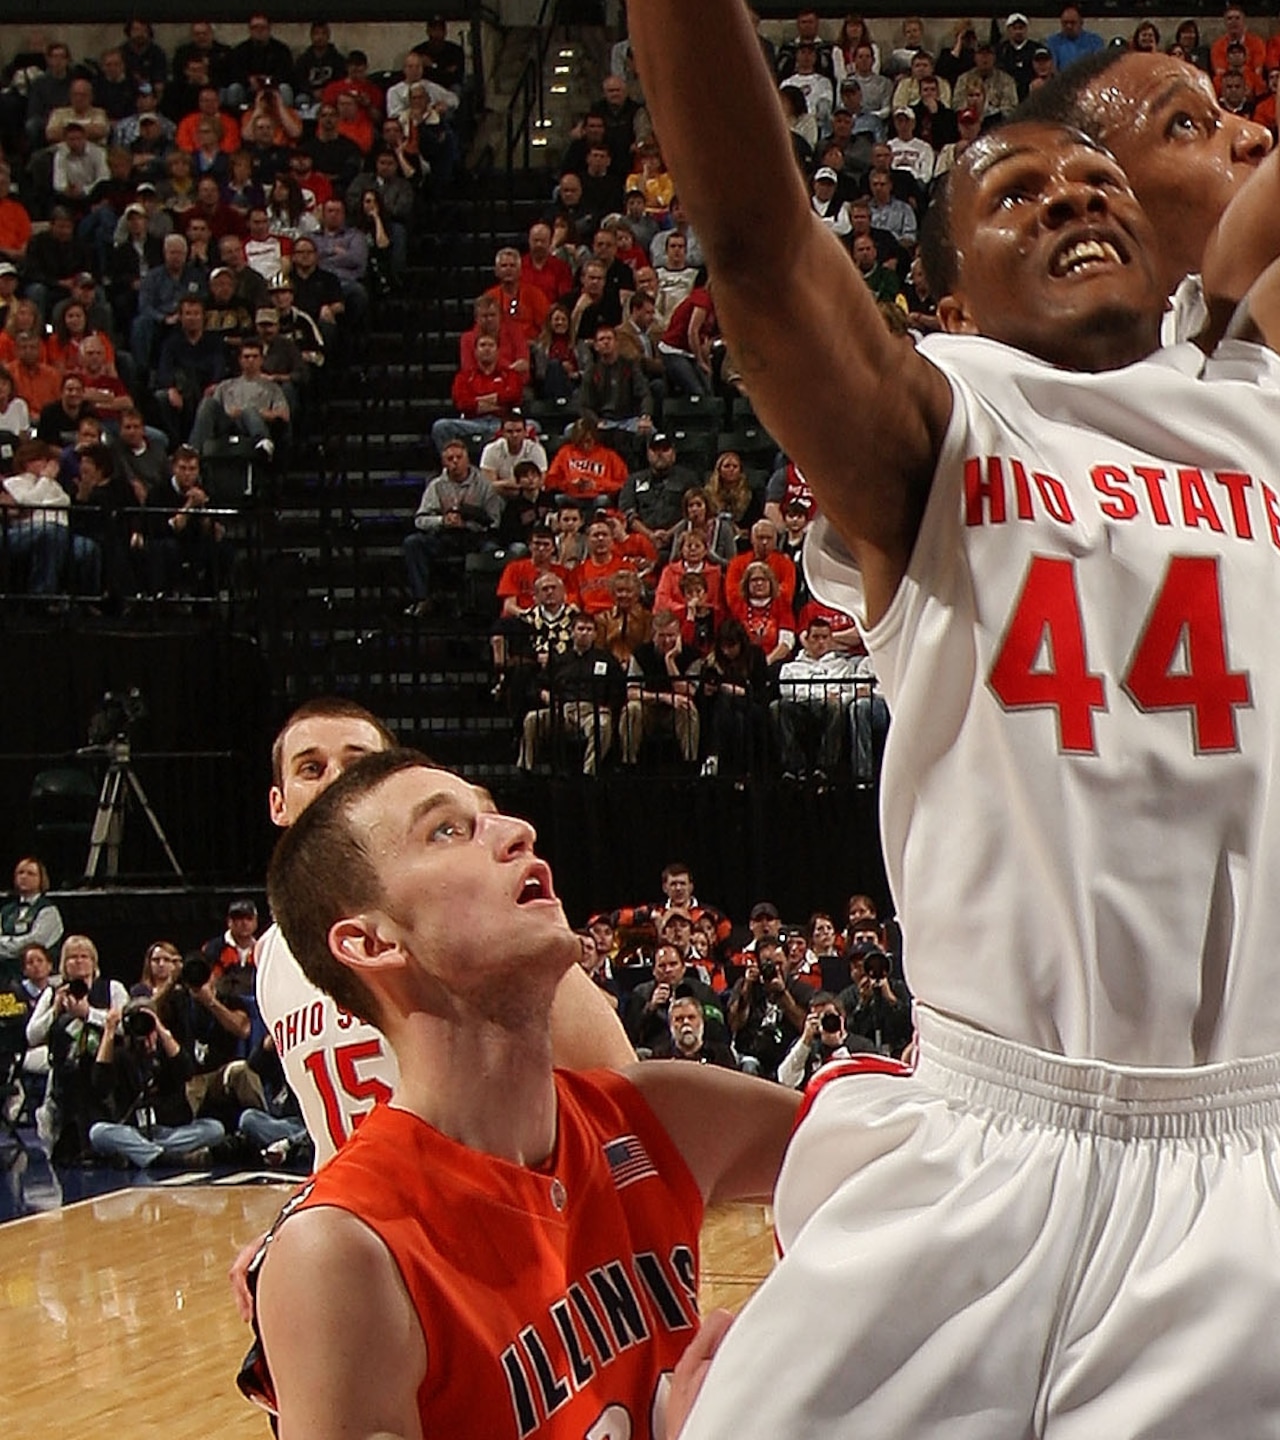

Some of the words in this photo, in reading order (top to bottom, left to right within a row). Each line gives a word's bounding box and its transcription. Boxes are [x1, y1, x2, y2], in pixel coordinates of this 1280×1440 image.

[964, 456, 1075, 528] HIO
[985, 550, 1254, 757] 44
[304, 1039, 394, 1154] 15
